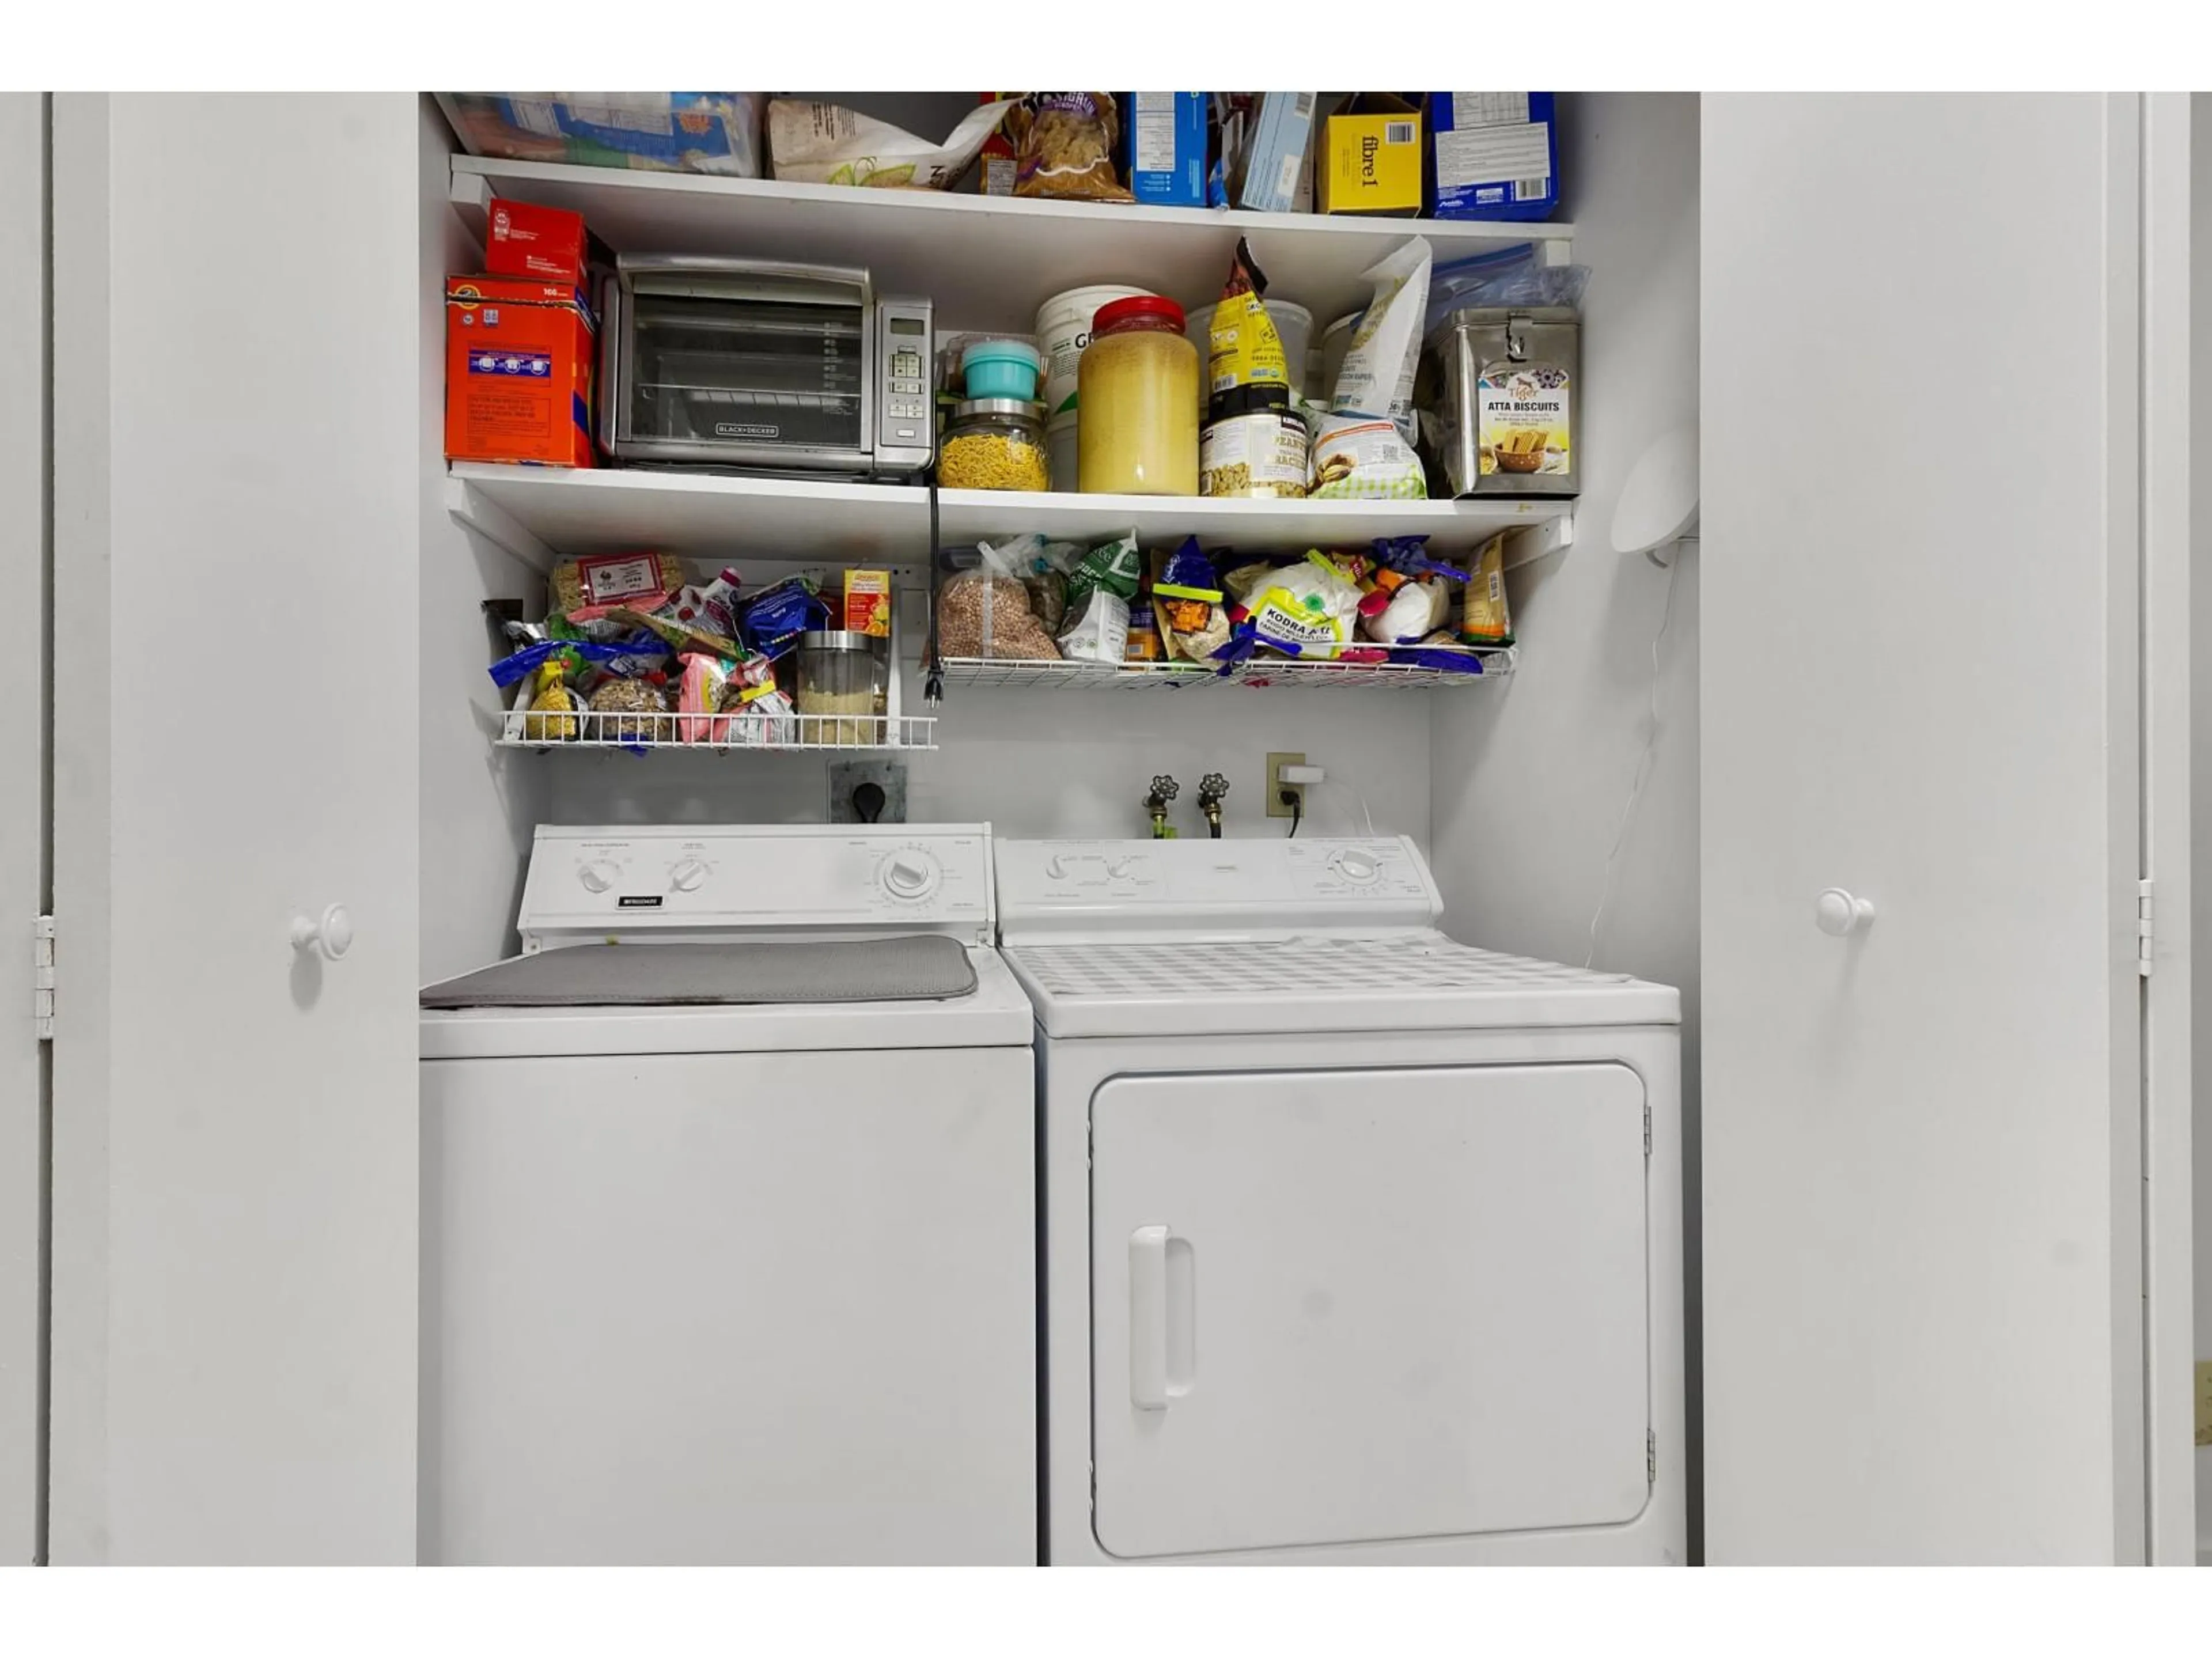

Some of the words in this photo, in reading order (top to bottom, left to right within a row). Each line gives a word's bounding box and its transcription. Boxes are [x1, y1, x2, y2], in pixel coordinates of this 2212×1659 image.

[1362, 135, 1378, 176] fibre
[1362, 179, 1378, 187] 1
[1508, 387, 1539, 401] Tiger
[1488, 402, 1510, 410] ATTA
[1514, 402, 1559, 411] BISCUITS
[1267, 608, 1305, 634] KODRA
